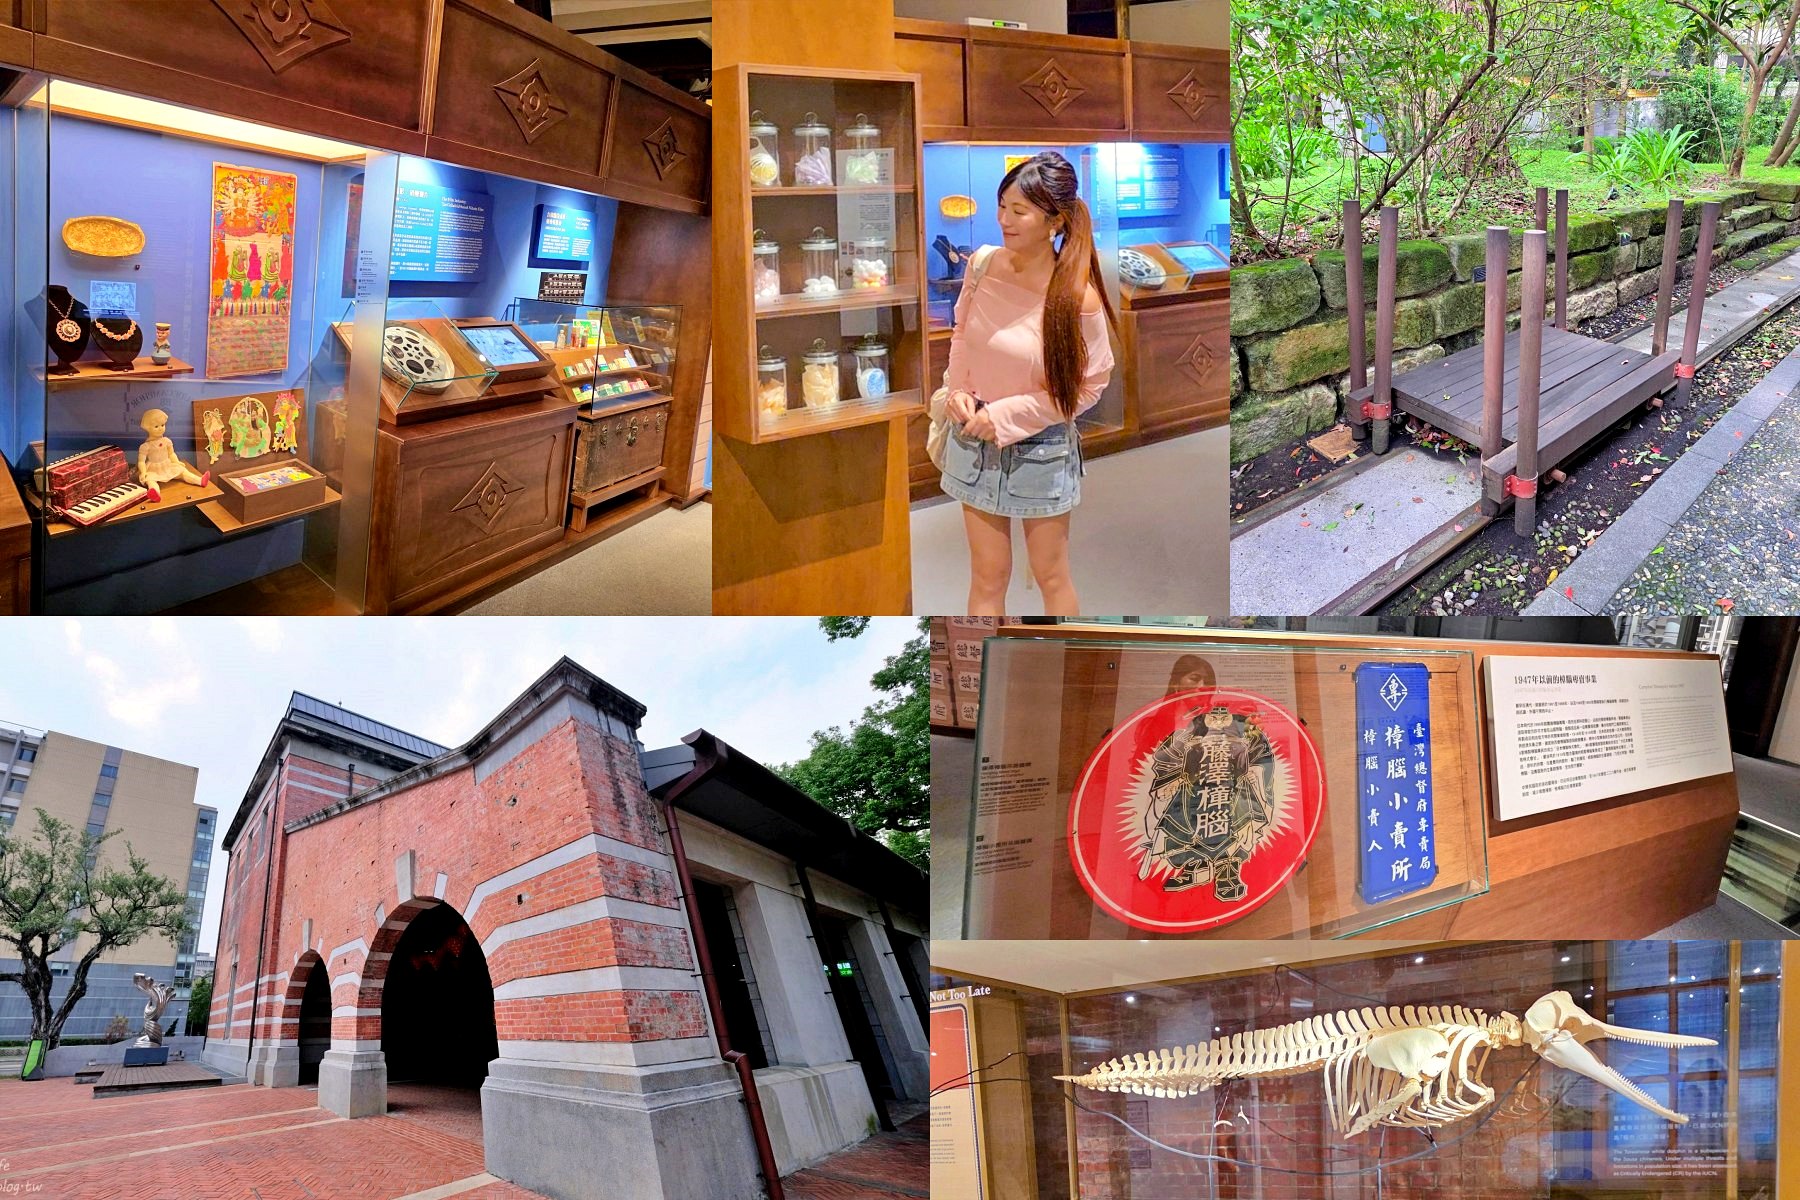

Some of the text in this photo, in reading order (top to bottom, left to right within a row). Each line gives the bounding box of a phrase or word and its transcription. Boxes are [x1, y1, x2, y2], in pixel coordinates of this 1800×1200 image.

[1387, 678, 1402, 704] 專
[1193, 736, 1232, 839] 藤澤樟腦
[1363, 728, 1383, 853] 樟腦小賣人
[1384, 724, 1413, 882] 樟腦小賣所
[930, 985, 991, 1002] Not Too Late
